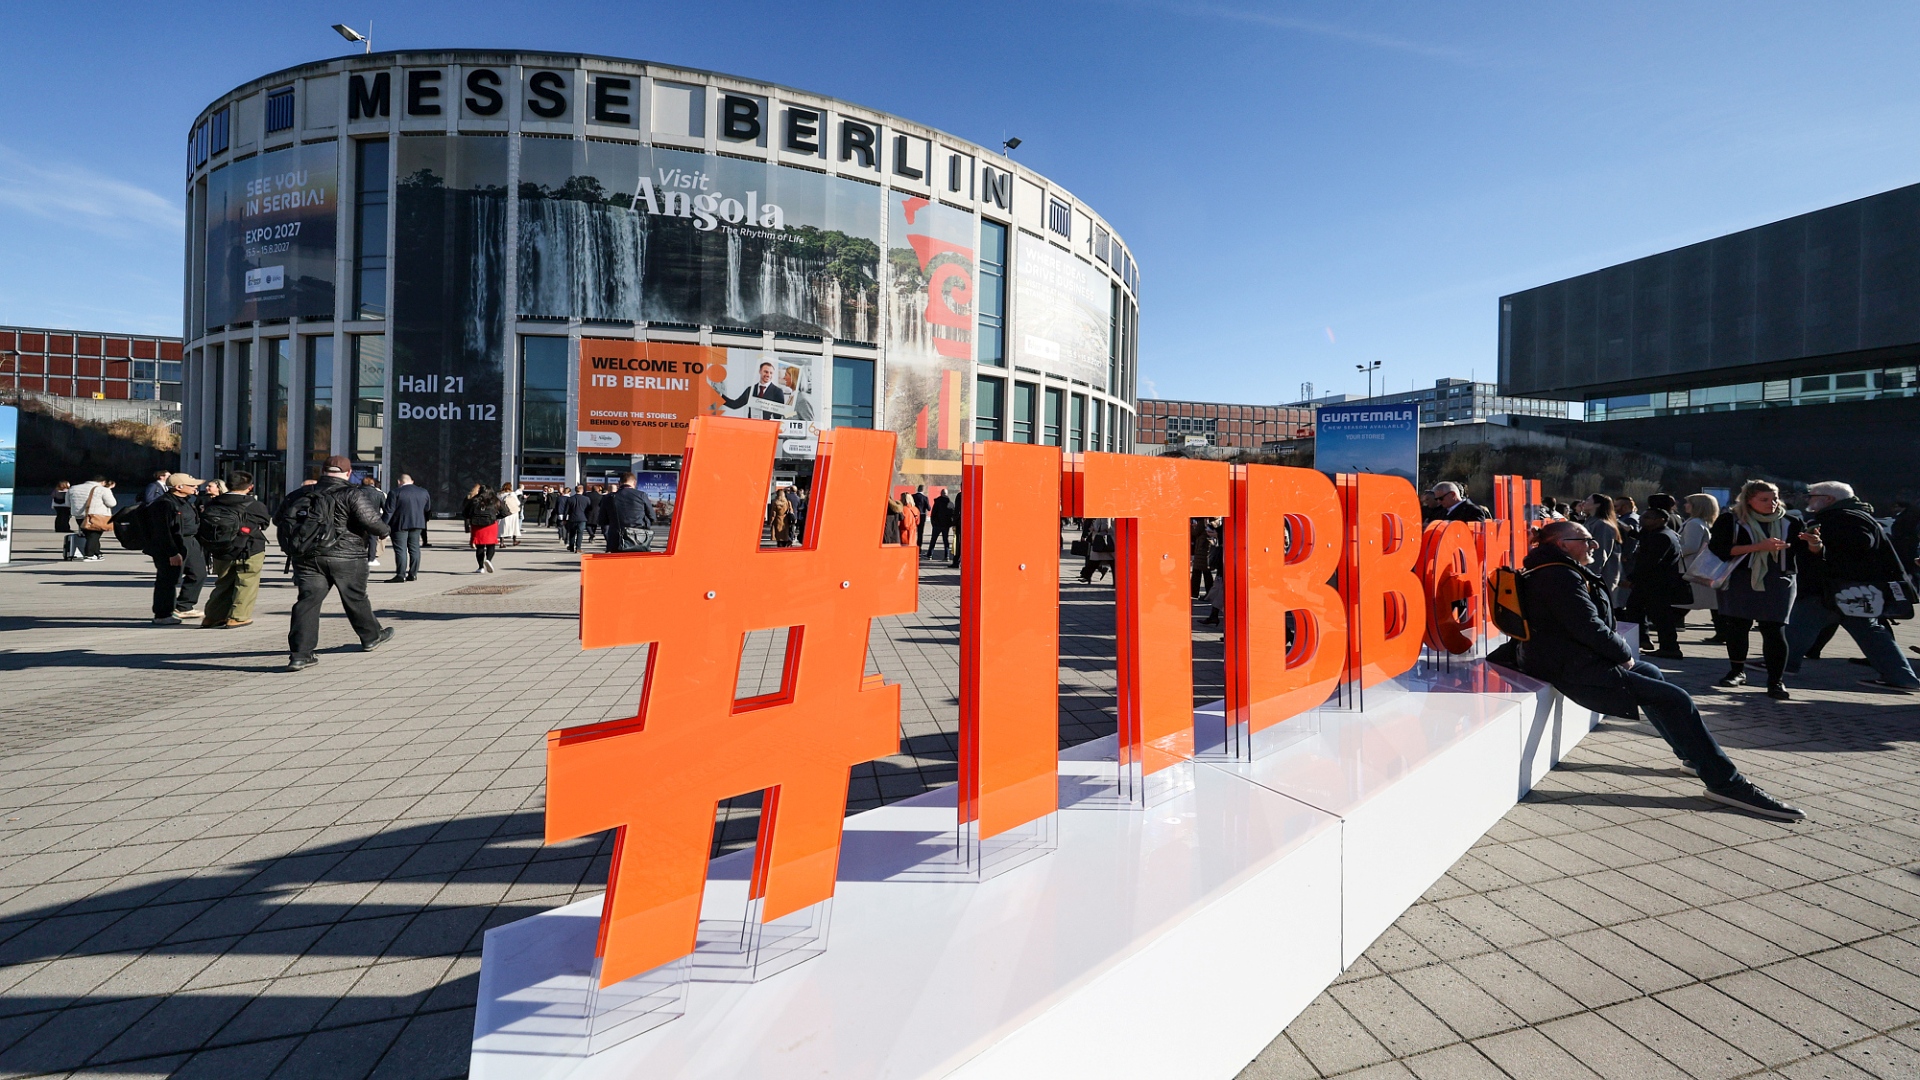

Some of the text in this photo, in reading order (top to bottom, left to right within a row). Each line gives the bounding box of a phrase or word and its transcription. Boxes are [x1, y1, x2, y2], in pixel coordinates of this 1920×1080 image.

[349, 69, 1009, 209] MESSE BERLIN
[247, 169, 308, 198] SEE YOU
[658, 167, 710, 191] Visit
[246, 188, 325, 217] IN SERBIA!
[628, 176, 785, 231] Angola
[246, 221, 302, 245] EXPO 2027
[721, 225, 805, 244] The Rhythm of Life
[261, 241, 290, 255] 15.8.2027
[1026, 247, 1087, 284] WHERE IDEAS
[1025, 262, 1095, 301] DRIVE BUSINESS
[591, 357, 704, 374] WELCOME TO
[399, 375, 464, 393] Hall 21
[591, 374, 690, 391] ITB BERLIN!
[398, 402, 496, 421] Booth 112
[590, 410, 629, 418] DISCOVER
[646, 412, 677, 420] STORIES
[1321, 411, 1413, 423] GUATEMALA
[620, 419, 630, 427] 60
[545, 417, 1567, 989] #ITBBerl
